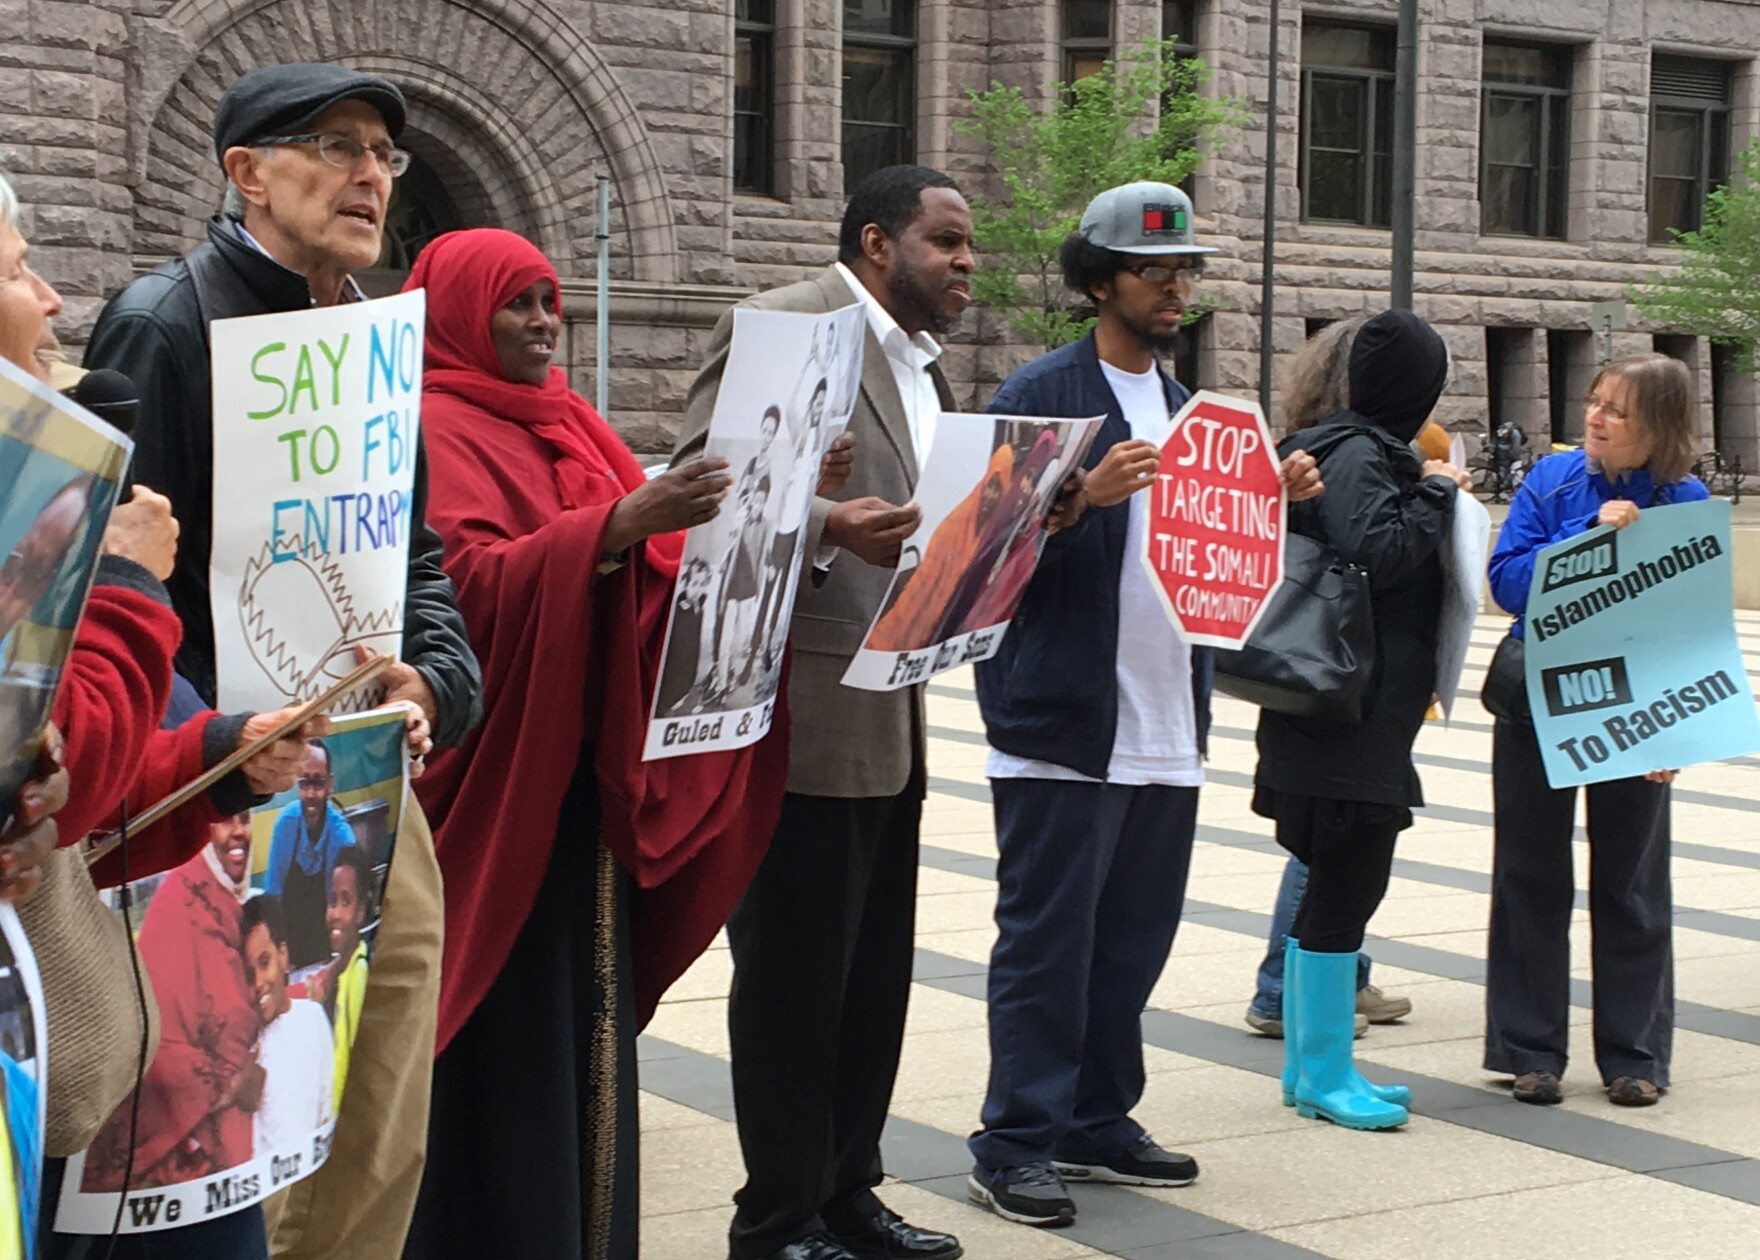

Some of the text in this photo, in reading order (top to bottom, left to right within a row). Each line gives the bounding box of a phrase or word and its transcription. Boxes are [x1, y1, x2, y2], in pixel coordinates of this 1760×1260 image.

[247, 318, 416, 420] SAY NO
[278, 408, 411, 482] TO FBI
[1177, 416, 1259, 478] STOP
[1157, 474, 1278, 541] TARGETING
[1156, 533, 1271, 590] THE SOMALI
[1531, 534, 1723, 643] Islamophobia
[1175, 583, 1261, 625] COMMUNITY
[887, 652, 929, 685] Free
[1558, 666, 1616, 707] NO!
[662, 715, 724, 747] Guled
[735, 711, 753, 737] &
[1556, 669, 1739, 772] To Racism
[128, 1152, 302, 1227] We Miss Our
